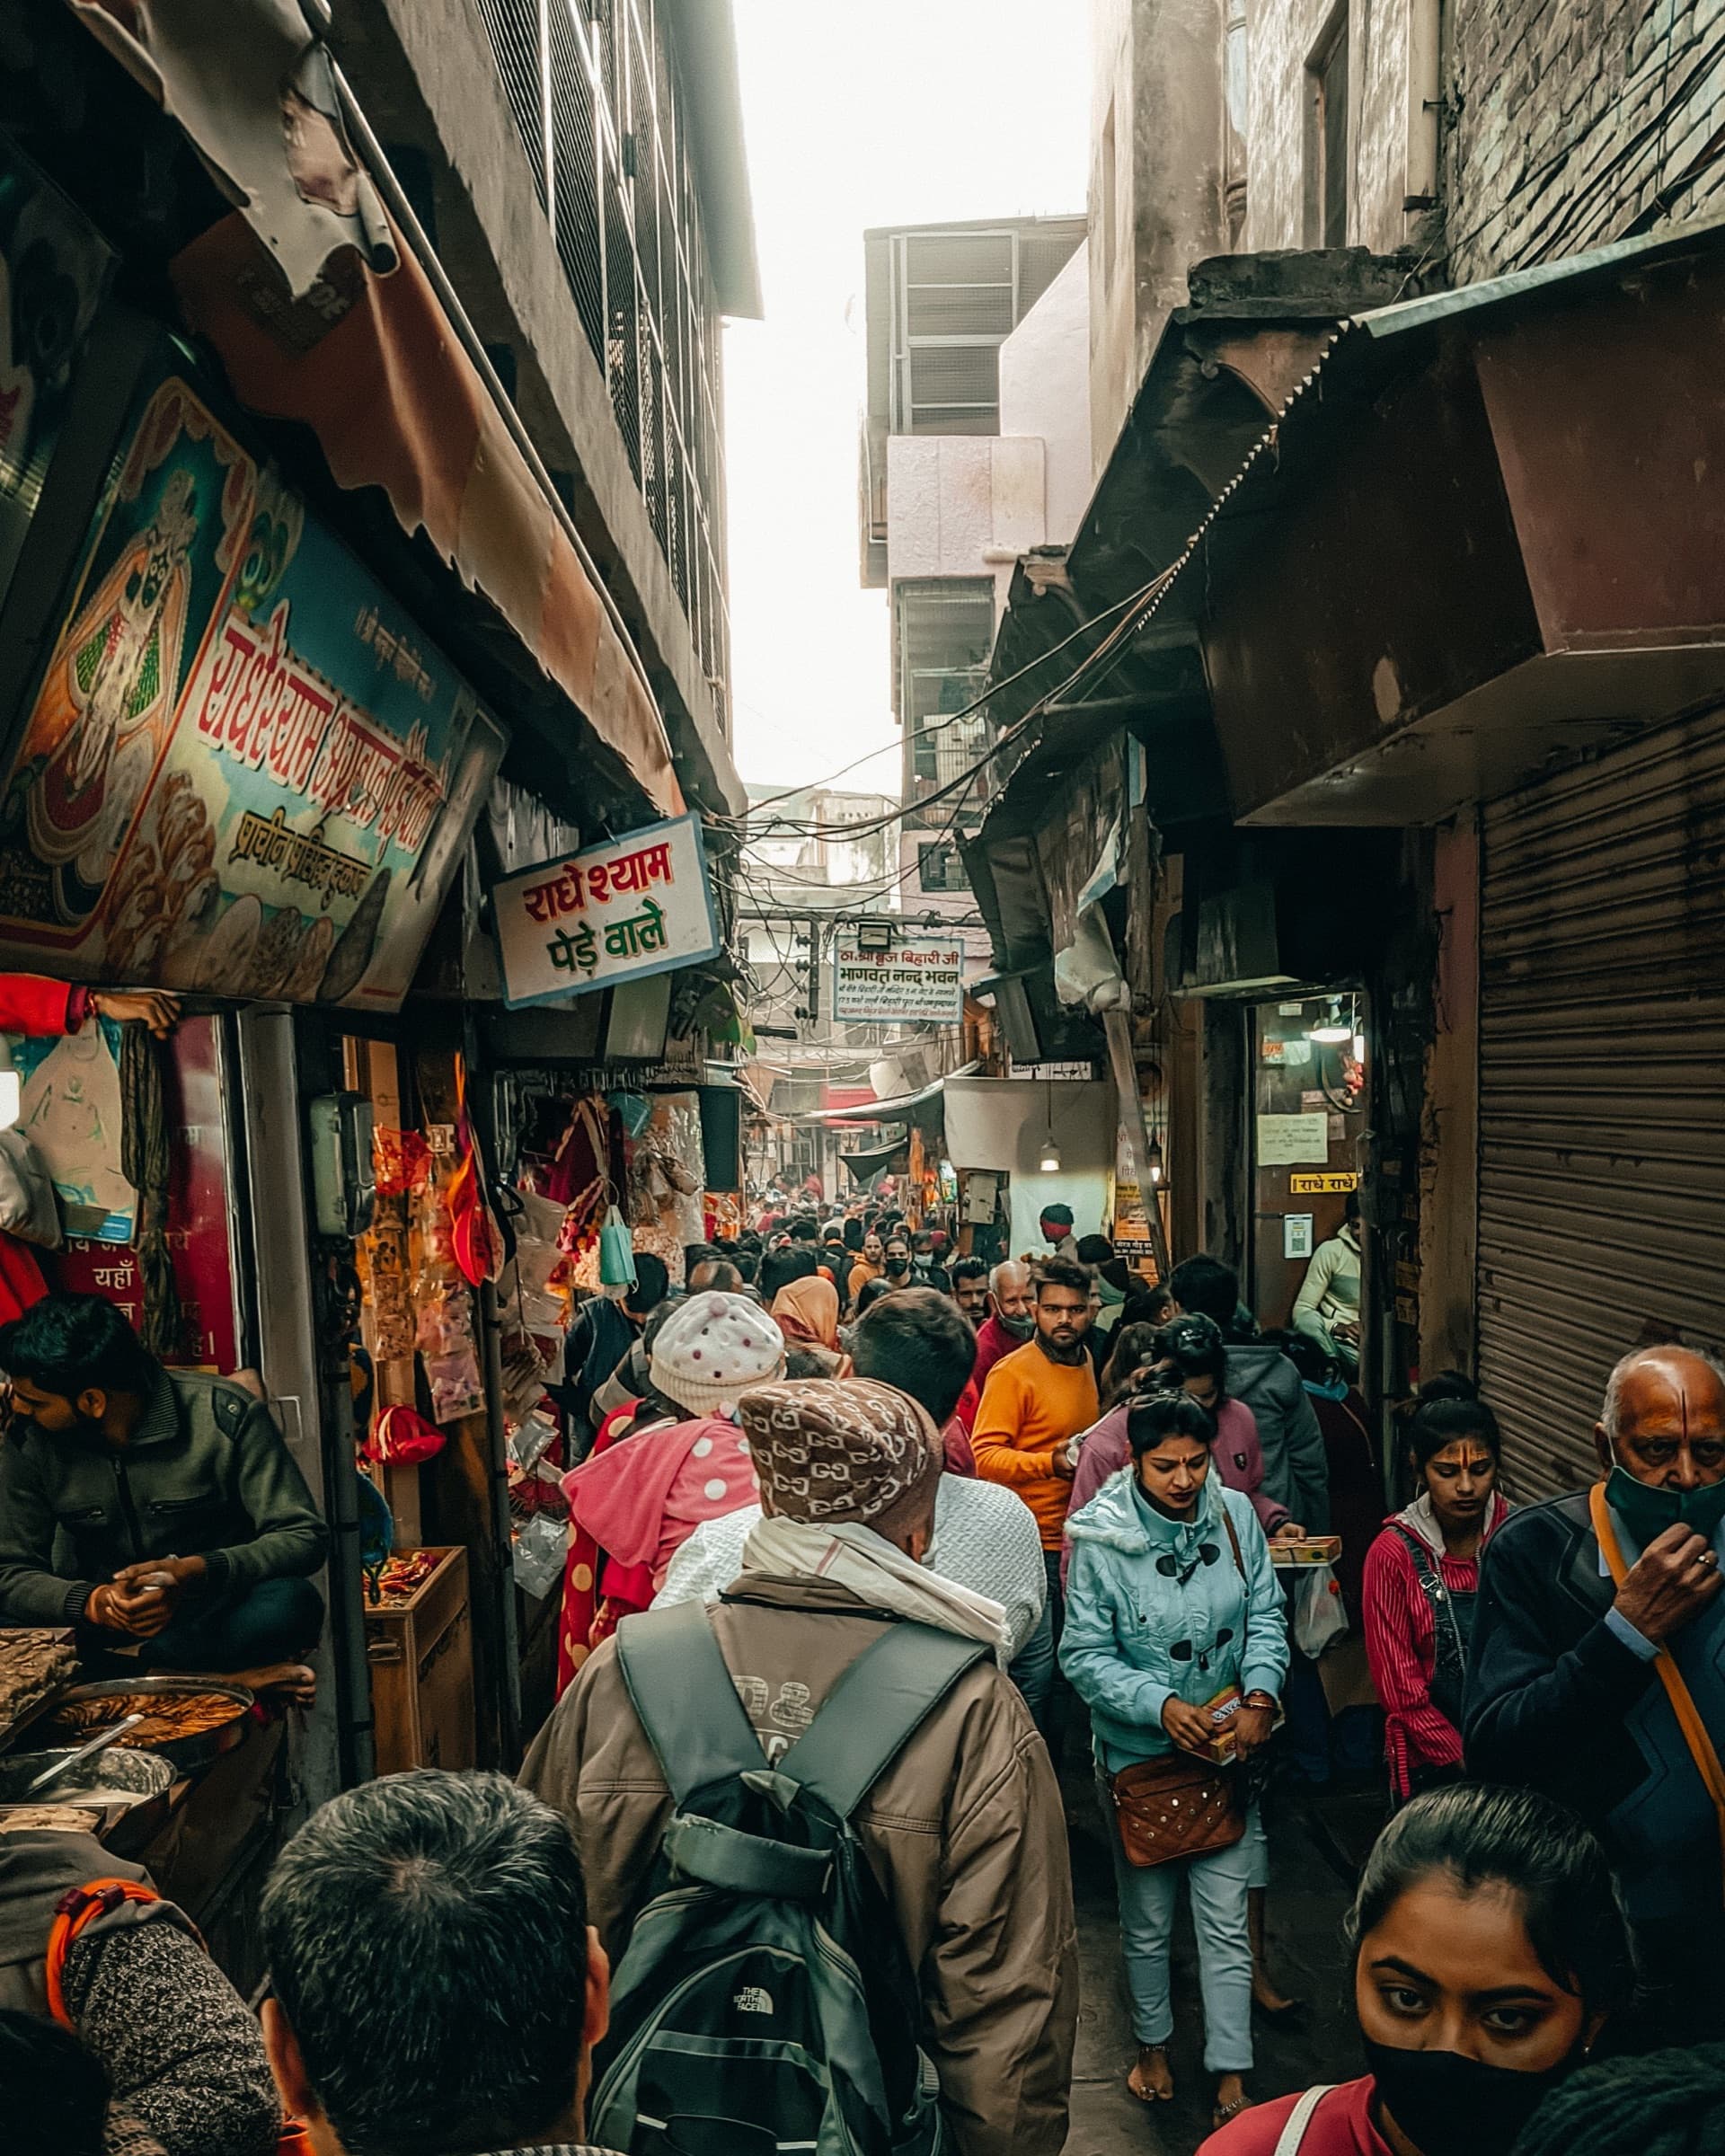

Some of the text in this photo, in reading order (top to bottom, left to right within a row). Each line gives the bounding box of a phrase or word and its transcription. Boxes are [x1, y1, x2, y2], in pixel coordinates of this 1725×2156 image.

[229, 806, 295, 871] प्राचीन
[546, 897, 666, 976] पेड़े वाले
[901, 950, 940, 966] बिहारी
[942, 951, 959, 965] जी
[925, 970, 959, 985] भवन
[1298, 1174, 1325, 1191] राधे
[1328, 1173, 1355, 1190] राधे
[93, 1259, 135, 1289] यहाँ
[743, 1986, 760, 1995] THE
